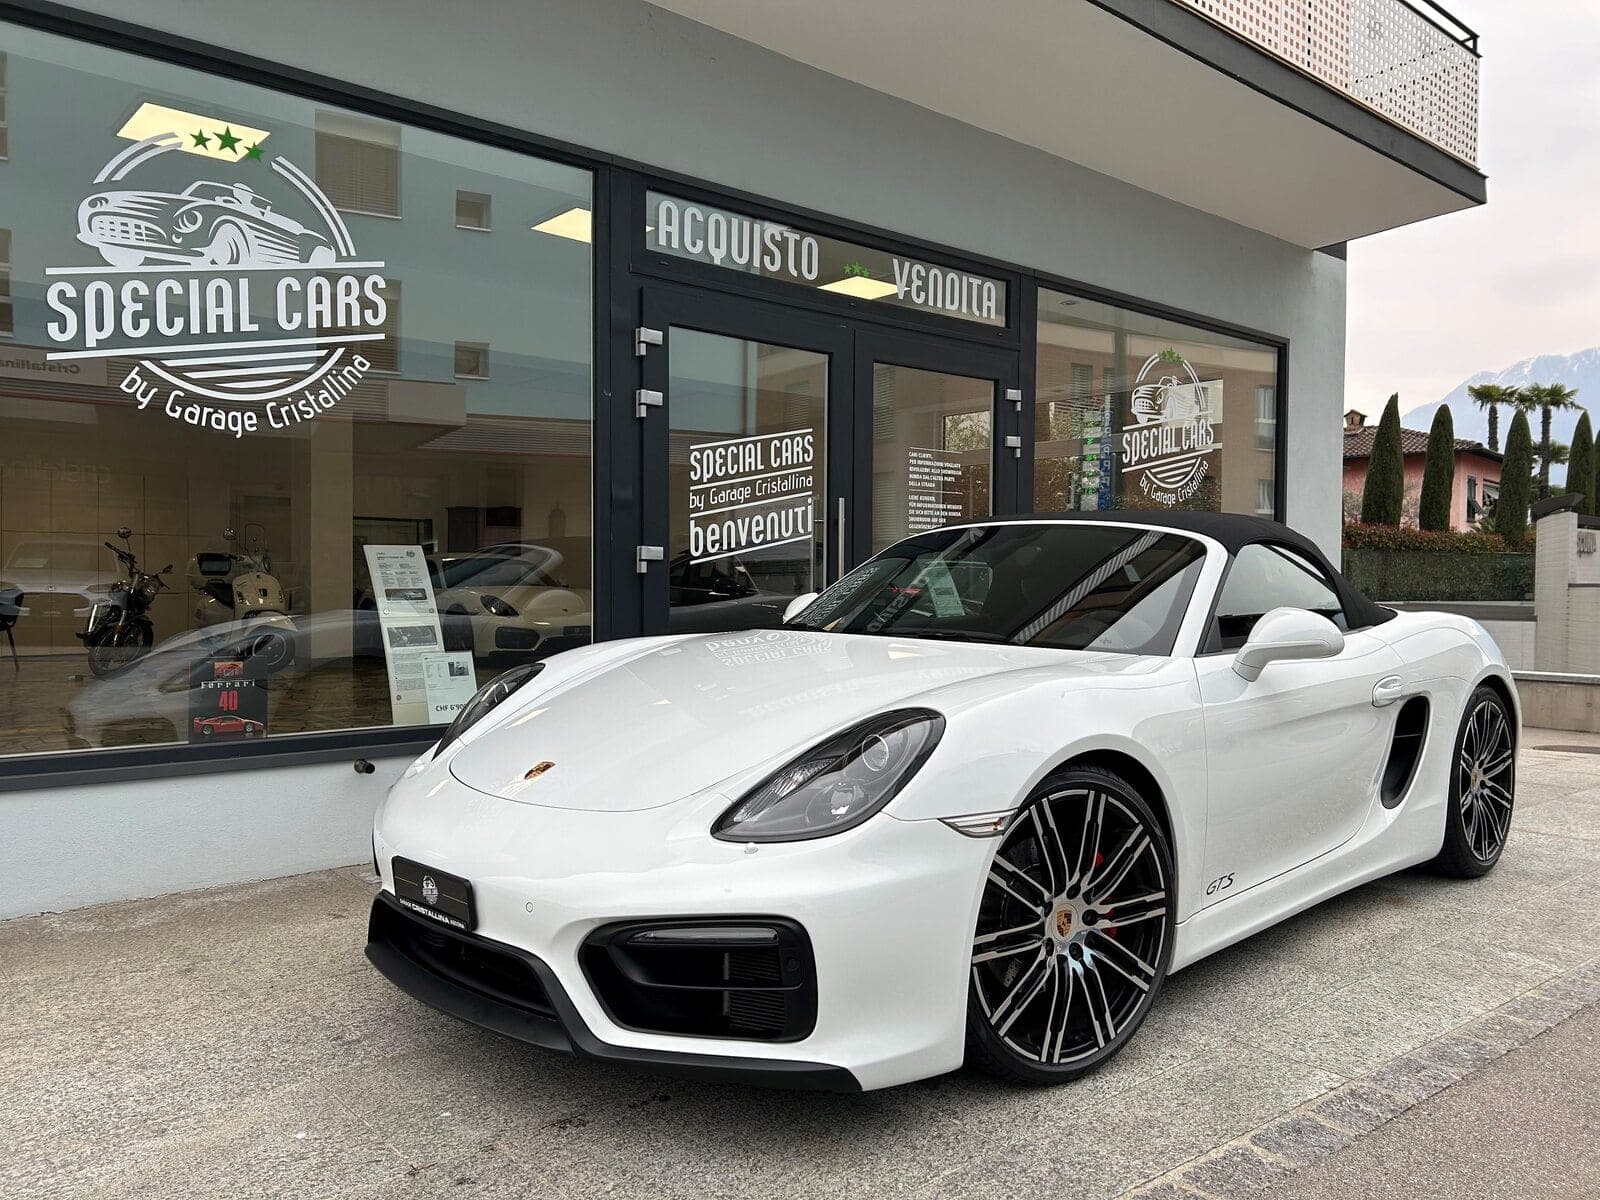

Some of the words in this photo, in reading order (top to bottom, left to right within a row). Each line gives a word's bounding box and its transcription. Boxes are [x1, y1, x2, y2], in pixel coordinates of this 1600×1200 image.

[658, 200, 819, 281] ACQUISTO
[892, 257, 996, 320] VENDITA
[46, 277, 258, 348] SPECIAL
[276, 274, 387, 331] CARS
[119, 366, 158, 410] by
[165, 389, 257, 438] Garage
[266, 354, 371, 429] Cristallina
[690, 442, 764, 482] SPECIAL
[770, 435, 813, 467] CARS
[1122, 425, 1181, 465] SPECIAL
[1182, 419, 1214, 450] CARS
[689, 492, 705, 510] by
[710, 485, 751, 503] Garage
[756, 474, 813, 496] Cristallina
[1139, 473, 1150, 495] by
[1150, 484, 1176, 507] Garage
[1177, 460, 1209, 501] Cristallina
[689, 497, 813, 557] benvenuti
[219, 690, 238, 711] 40
[435, 704, 449, 712] CHF
[450, 703, 465, 711] 6'90
[1206, 872, 1234, 895] GTS
